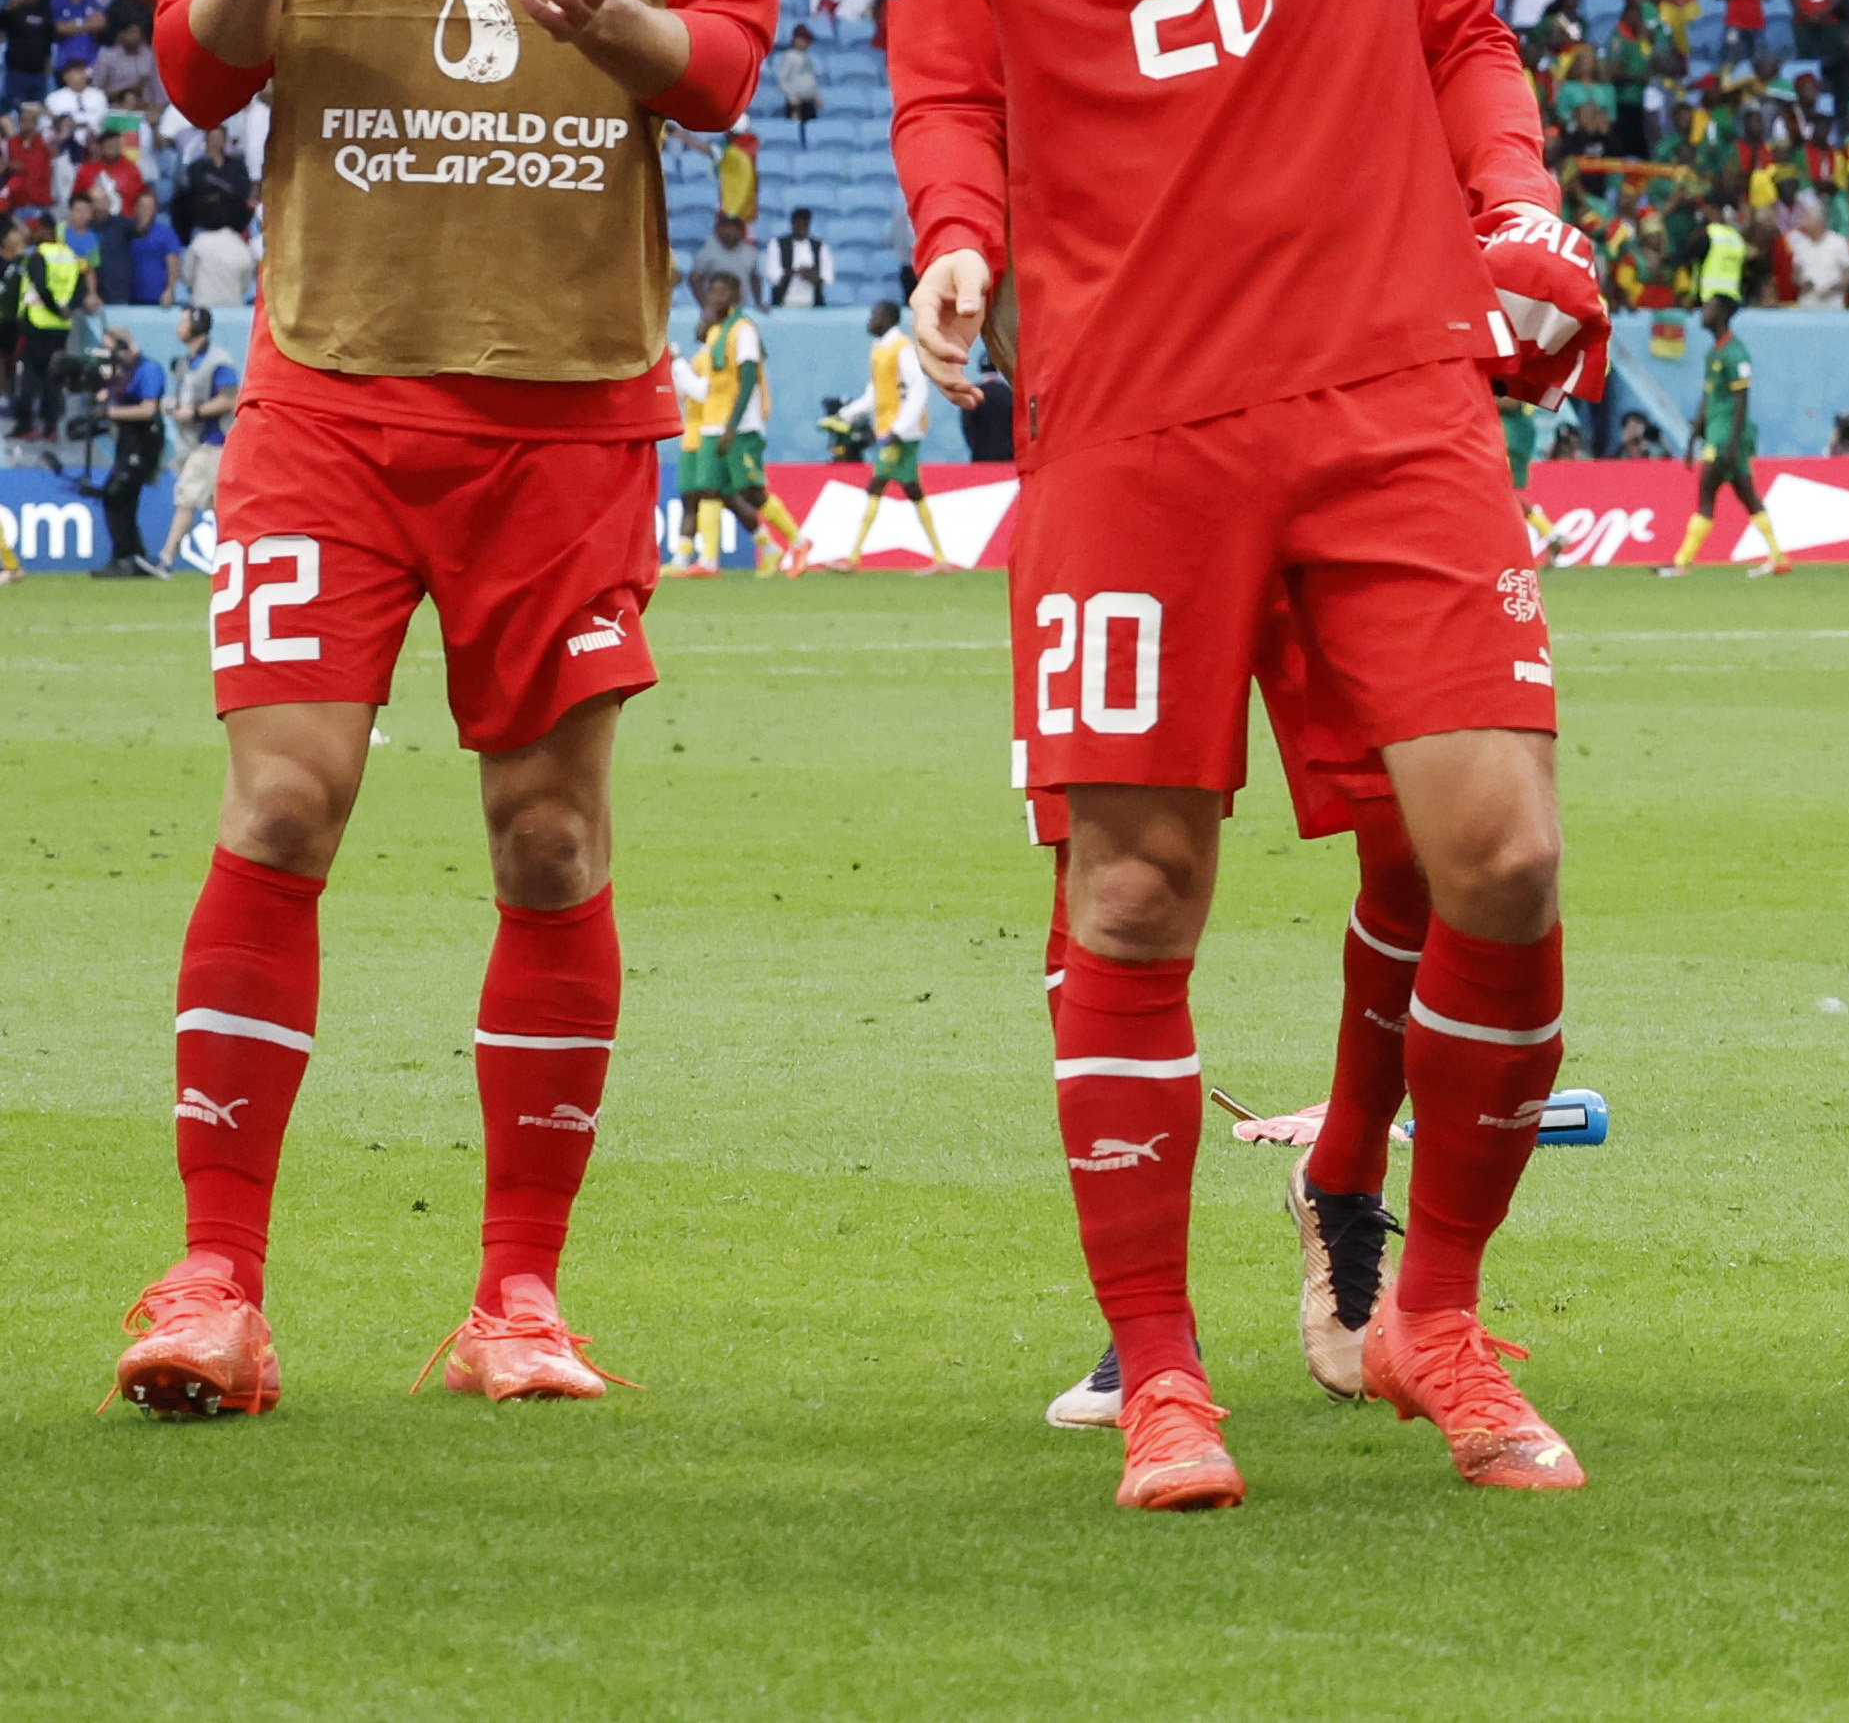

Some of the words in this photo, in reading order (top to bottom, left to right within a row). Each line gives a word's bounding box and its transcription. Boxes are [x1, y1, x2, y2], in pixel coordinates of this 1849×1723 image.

[321, 108, 398, 141] FIFA
[403, 109, 546, 144] WORLD
[552, 115, 629, 148] CUP
[335, 144, 606, 194] Qatar2022
[210, 534, 321, 671] 22
[567, 629, 622, 658] PUMA
[1036, 591, 1162, 735] 20
